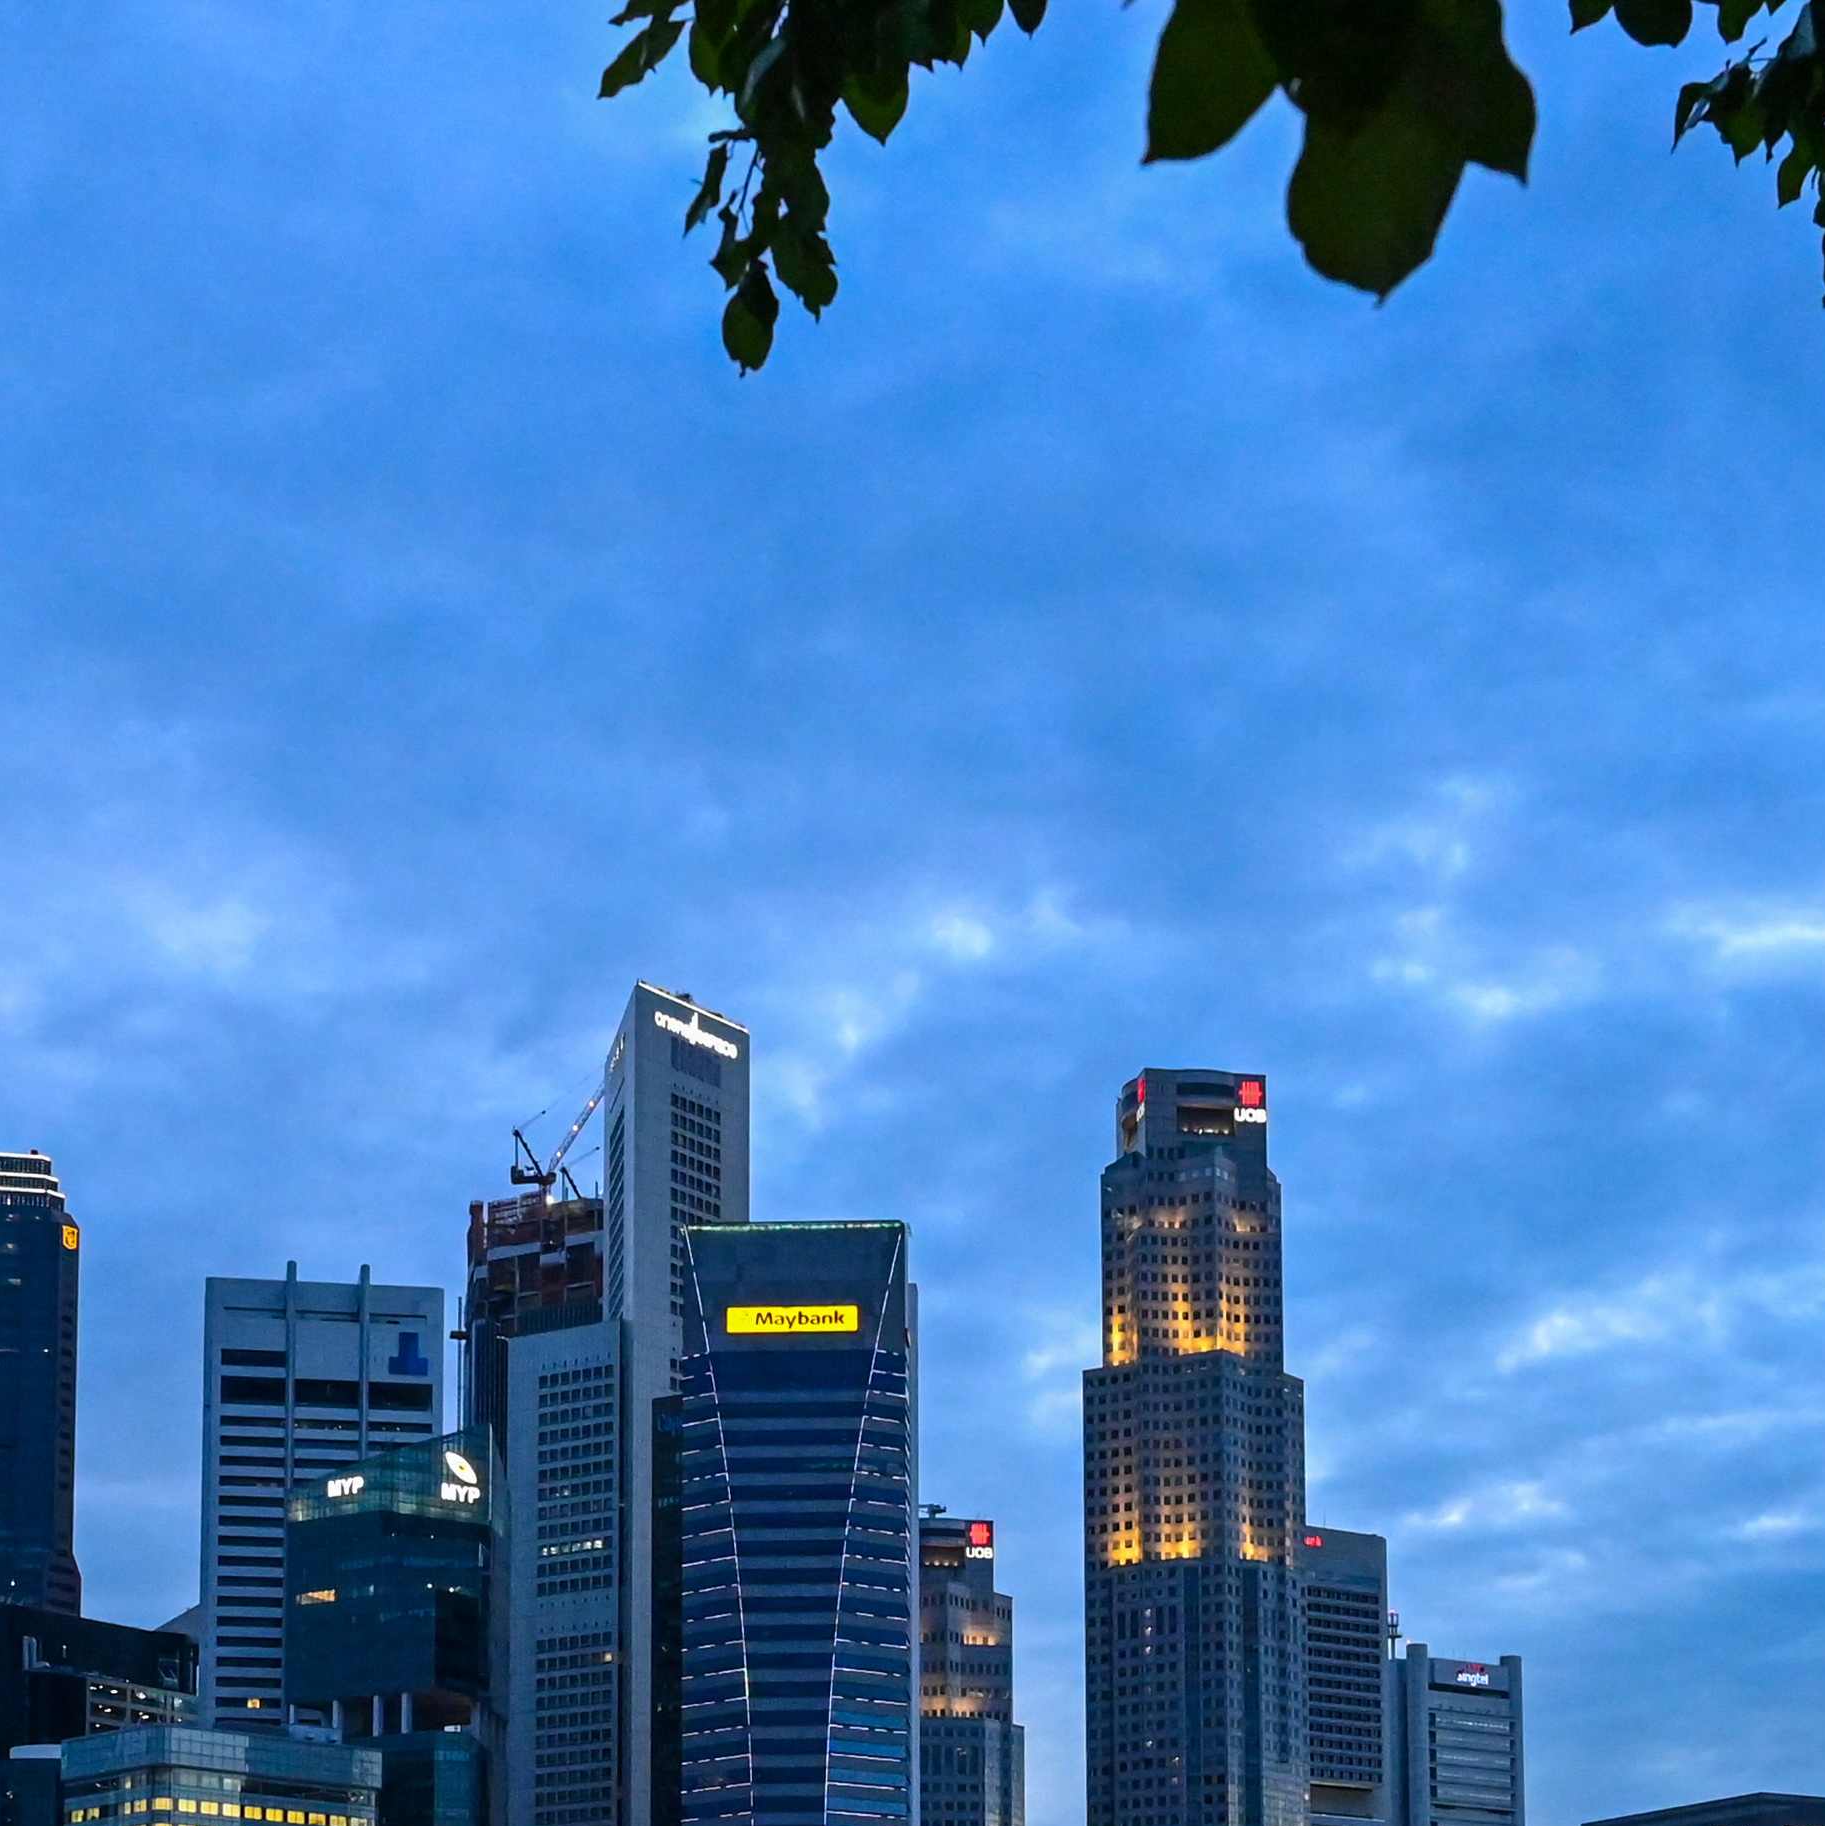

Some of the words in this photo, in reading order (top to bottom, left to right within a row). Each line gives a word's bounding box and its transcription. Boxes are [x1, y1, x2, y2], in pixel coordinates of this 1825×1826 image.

[1233, 1107, 1267, 1124] UOB
[755, 1310, 845, 1330] Maybank
[327, 1476, 364, 1498] MYP
[441, 1482, 480, 1504] MYP
[965, 1546, 993, 1559] UOB
